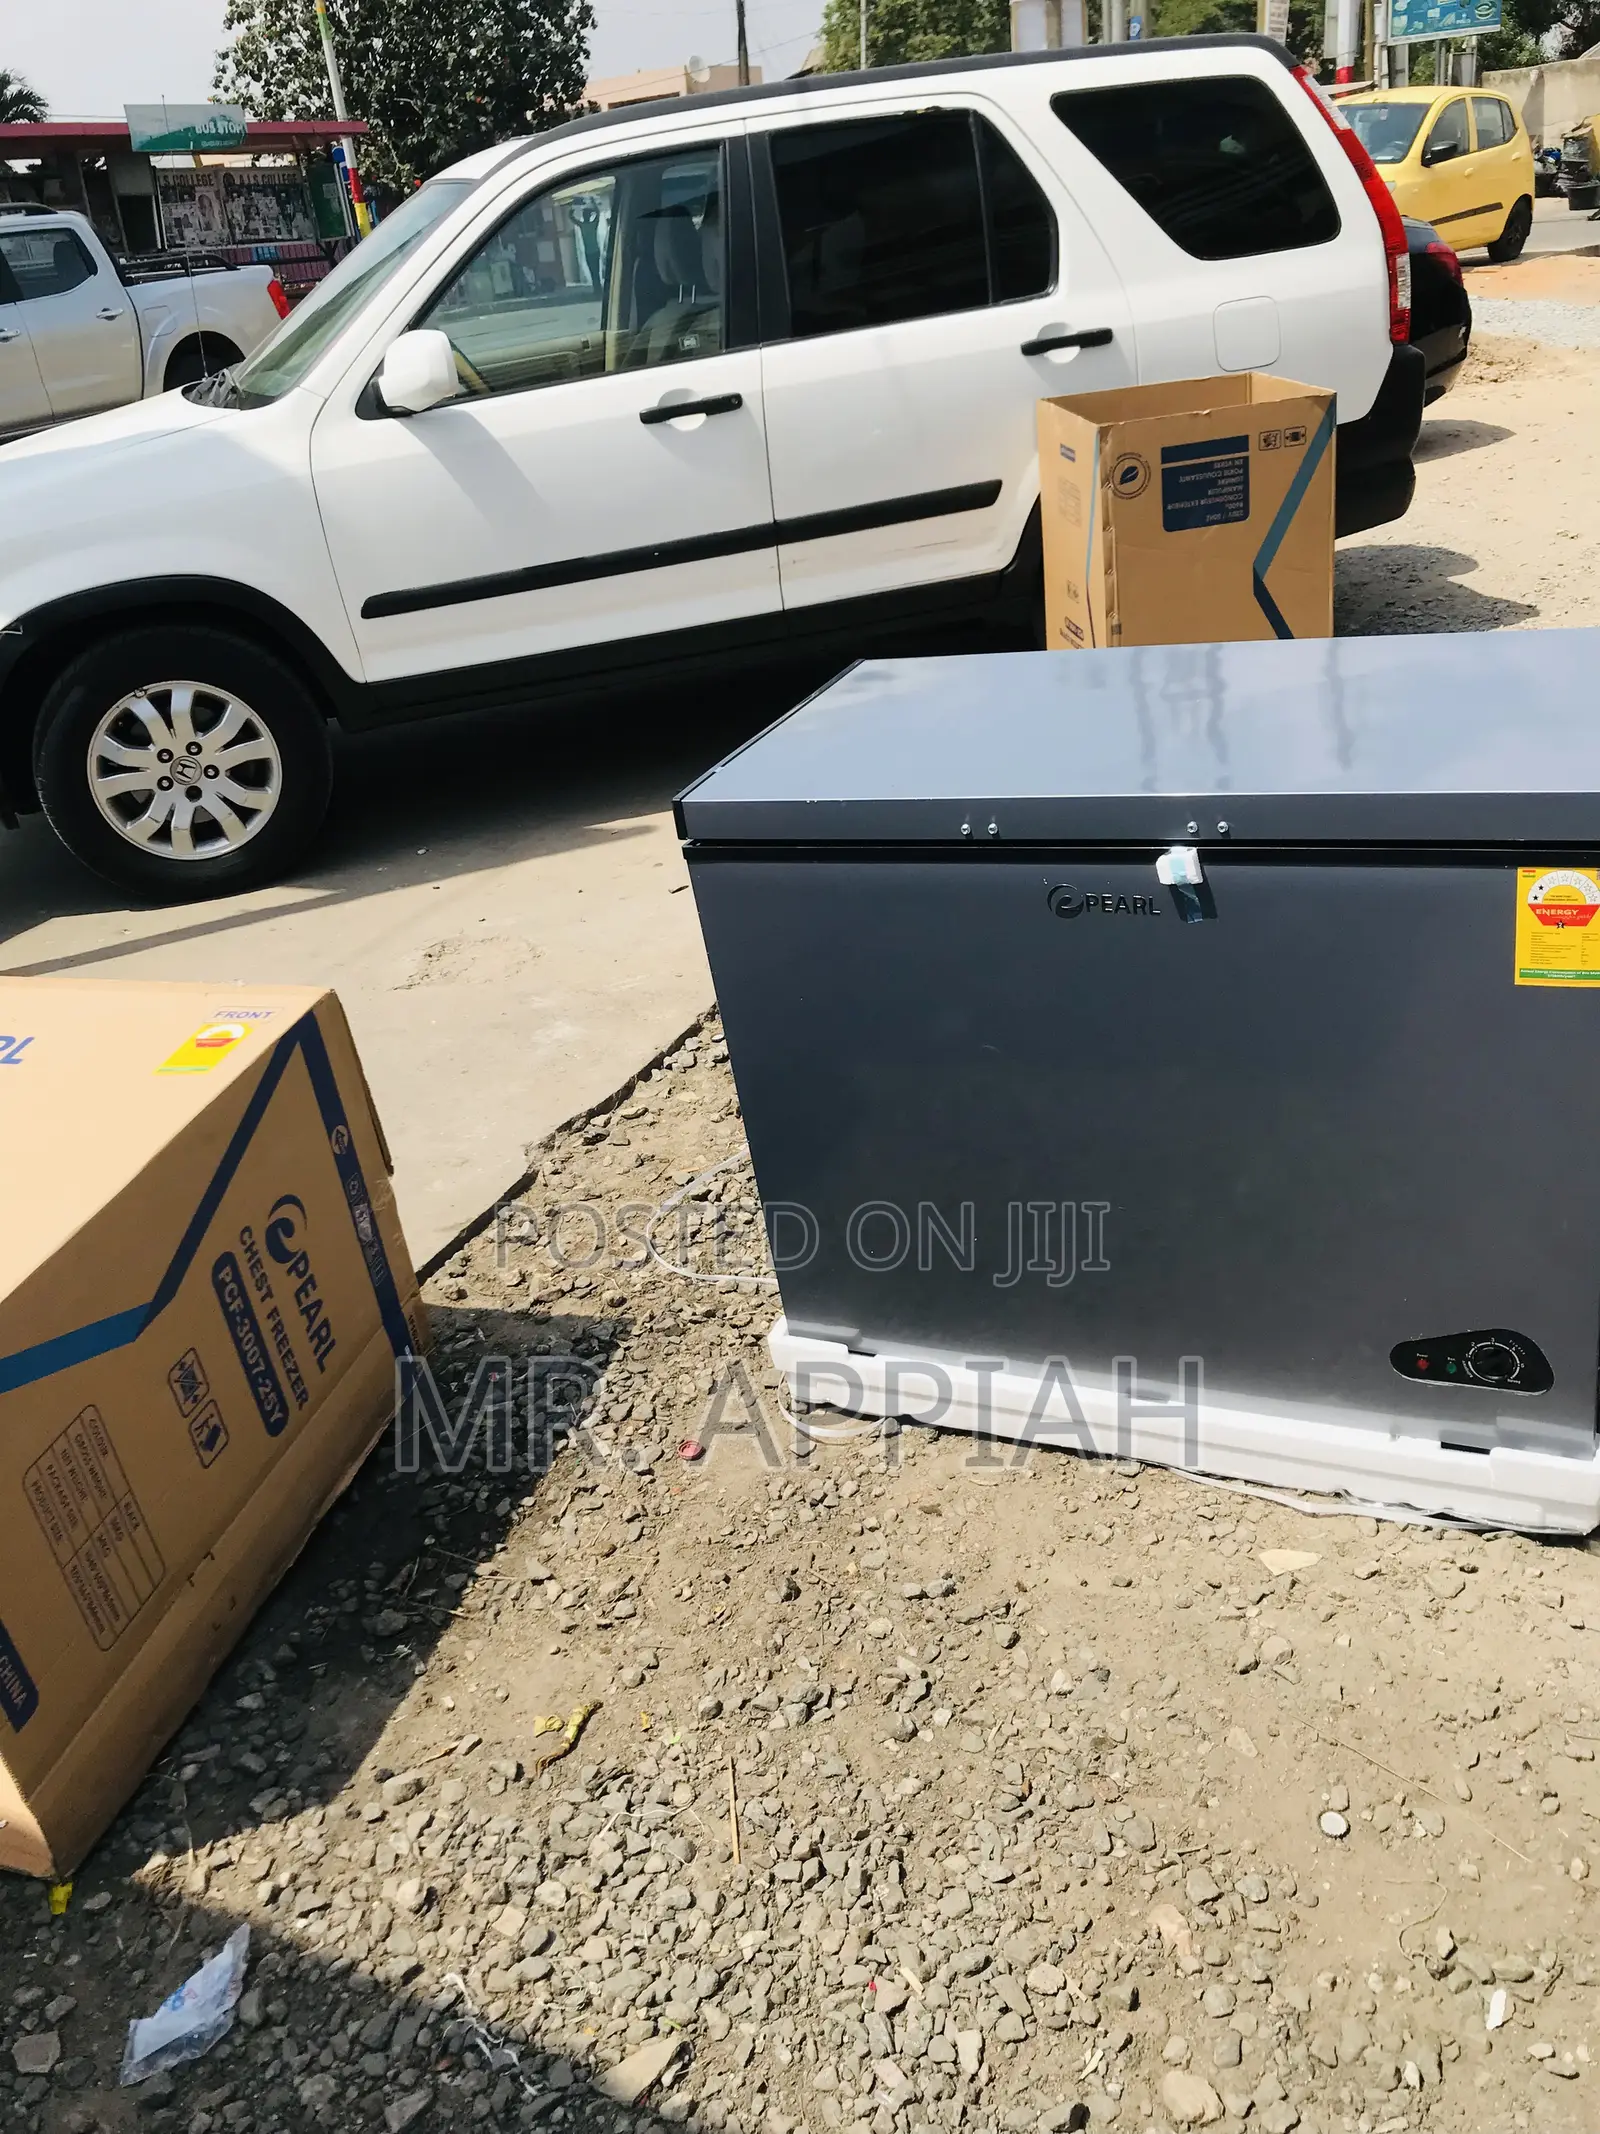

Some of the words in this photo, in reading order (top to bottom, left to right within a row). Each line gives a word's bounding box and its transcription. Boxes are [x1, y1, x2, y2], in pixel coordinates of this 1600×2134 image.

[195, 121, 216, 134] BUS
[173, 172, 215, 188] COLLEGE
[260, 172, 298, 186] COLLEGE
[1085, 892, 1161, 916] PEARL
[1536, 908, 1579, 917] ENERGY
[213, 1009, 275, 1020] FRONT
[239, 1224, 274, 1304] CHEST
[265, 1304, 310, 1412] FREEZER
[286, 1249, 337, 1375] PEARL
[0, 1655, 27, 1709] CHINA
